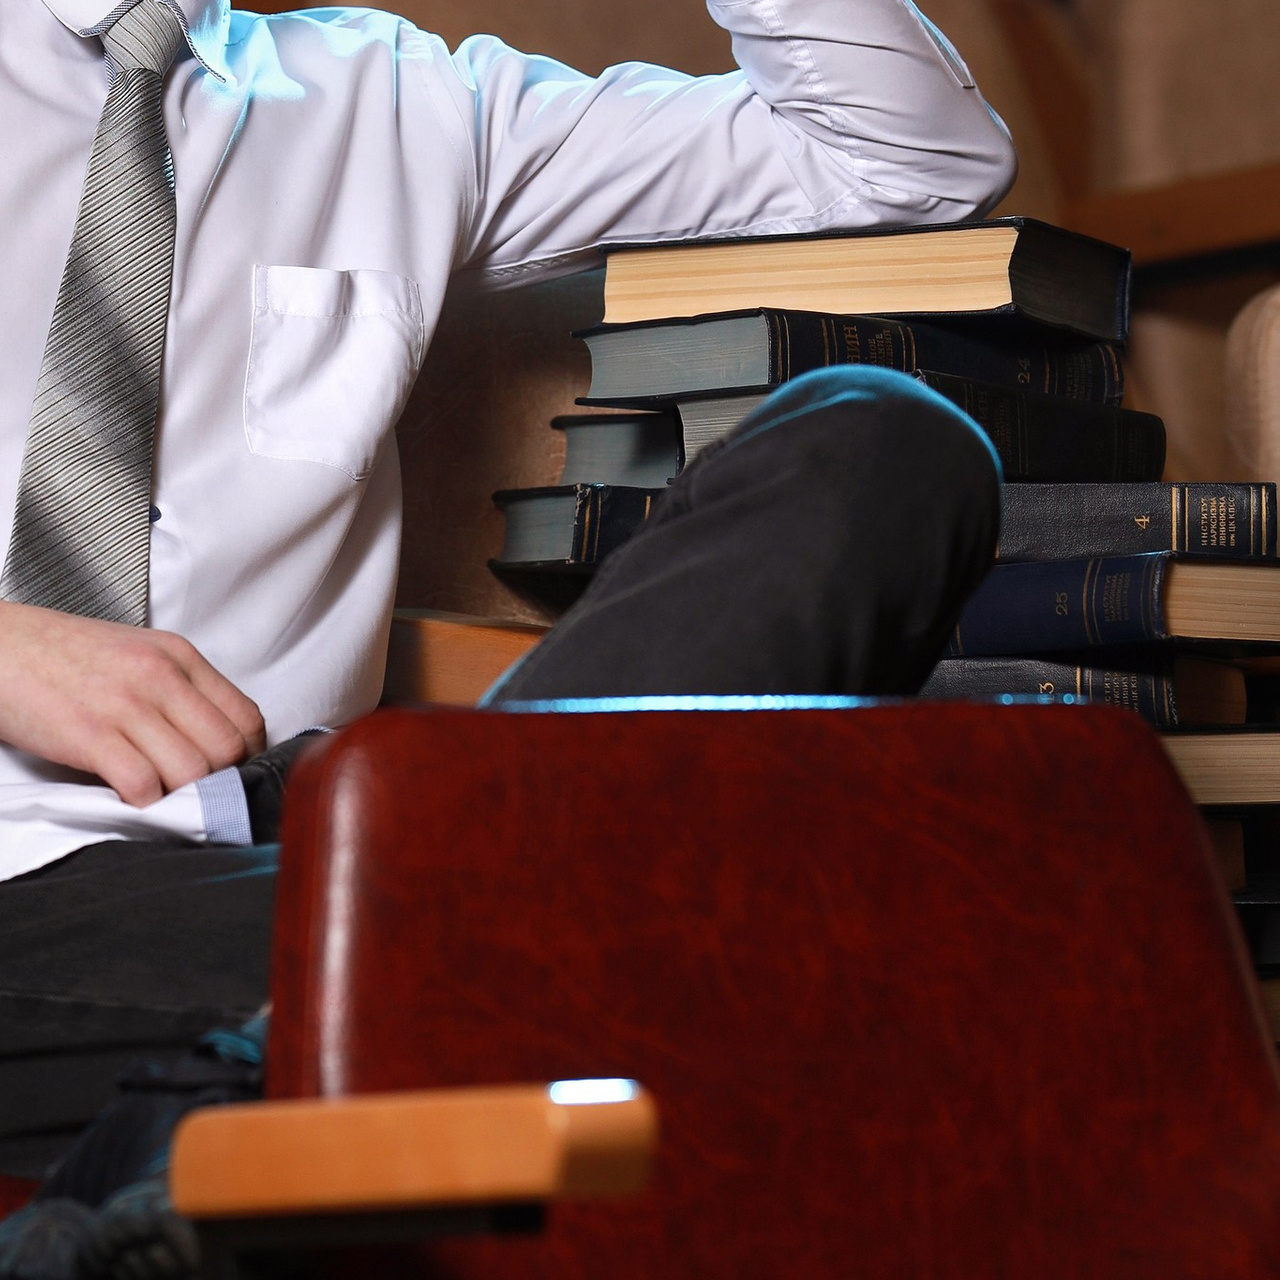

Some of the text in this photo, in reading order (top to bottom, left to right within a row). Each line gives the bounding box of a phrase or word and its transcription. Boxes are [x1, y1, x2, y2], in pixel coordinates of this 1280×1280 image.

[1227, 496, 1236, 519] КПСС
[1133, 513, 1151, 530] 4
[1200, 497, 1208, 547] ИНСТИТУТ
[1209, 496, 1217, 547] МАРКСИЗМА
[1219, 495, 1227, 548] ЛЕНИНИЗМА
[1227, 520, 1236, 532] ЦК
[1055, 591, 1069, 616] 25
